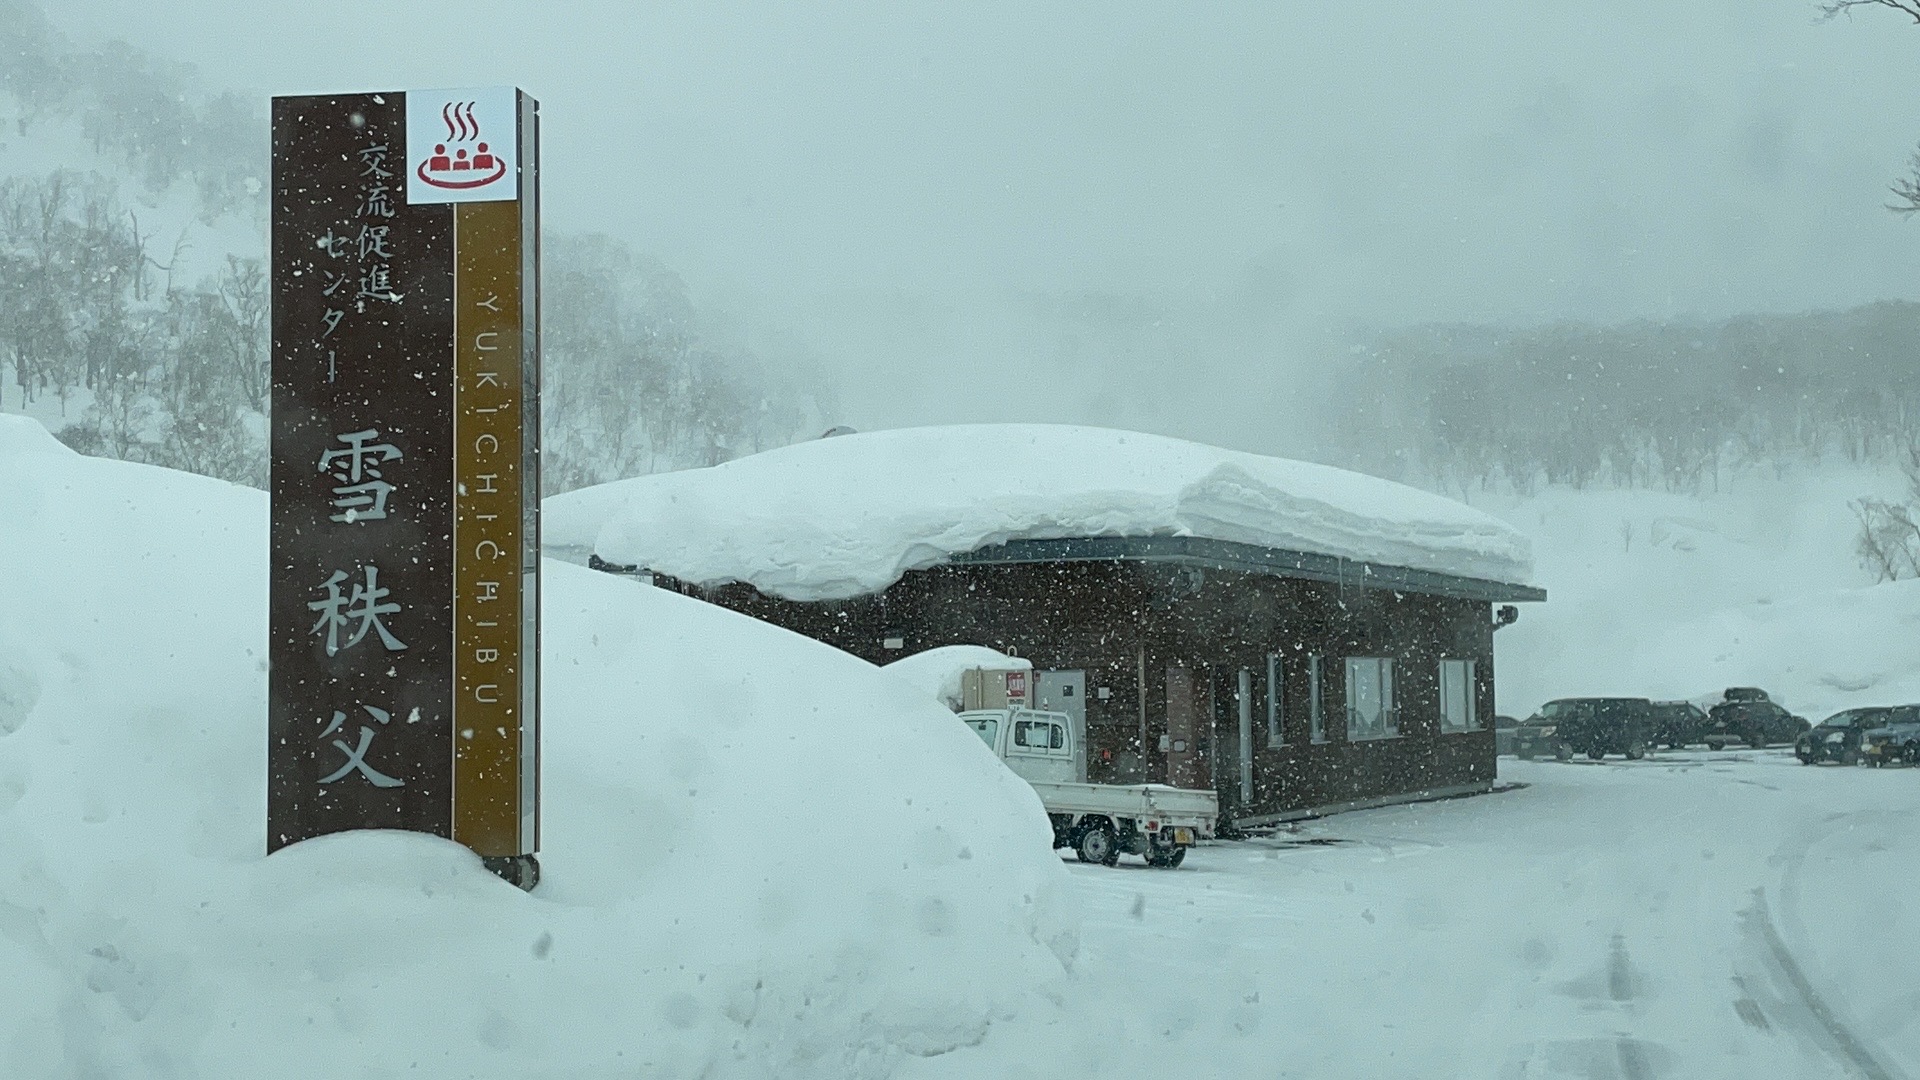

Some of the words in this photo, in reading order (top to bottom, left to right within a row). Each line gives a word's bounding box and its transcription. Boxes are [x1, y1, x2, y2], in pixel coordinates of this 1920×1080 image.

[318, 231, 350, 383] センター
[356, 142, 396, 301] 交流促進
[308, 428, 408, 788] 雪秩父
[475, 294, 499, 704] YUKICHICHIBU
